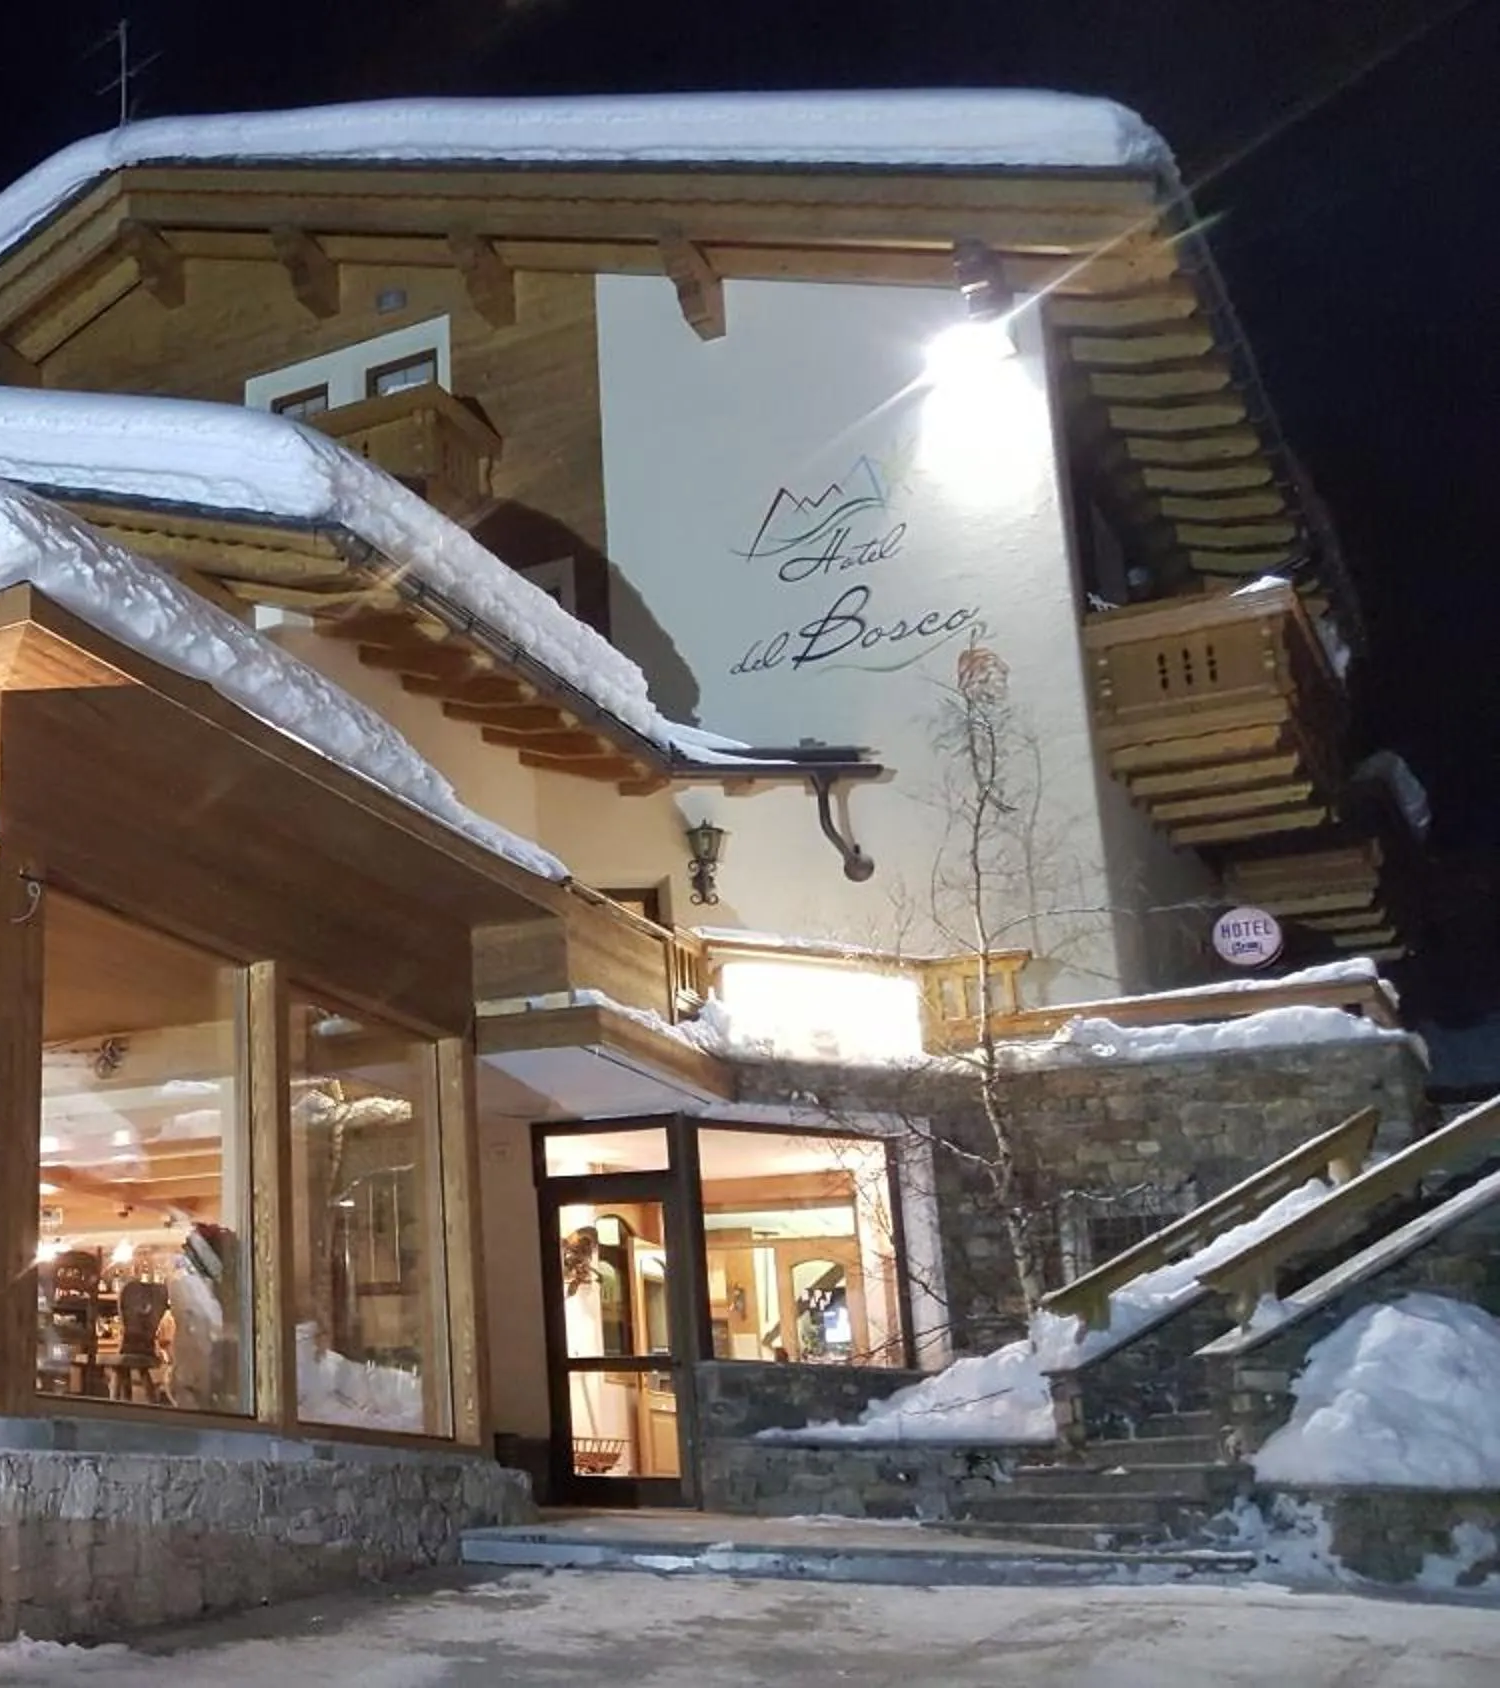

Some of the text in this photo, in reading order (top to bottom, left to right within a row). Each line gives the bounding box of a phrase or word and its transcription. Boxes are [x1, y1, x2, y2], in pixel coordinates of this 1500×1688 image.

[778, 523, 906, 582] Hotel
[729, 585, 979, 675] del Bosco
[1221, 919, 1272, 939] HOTEL
